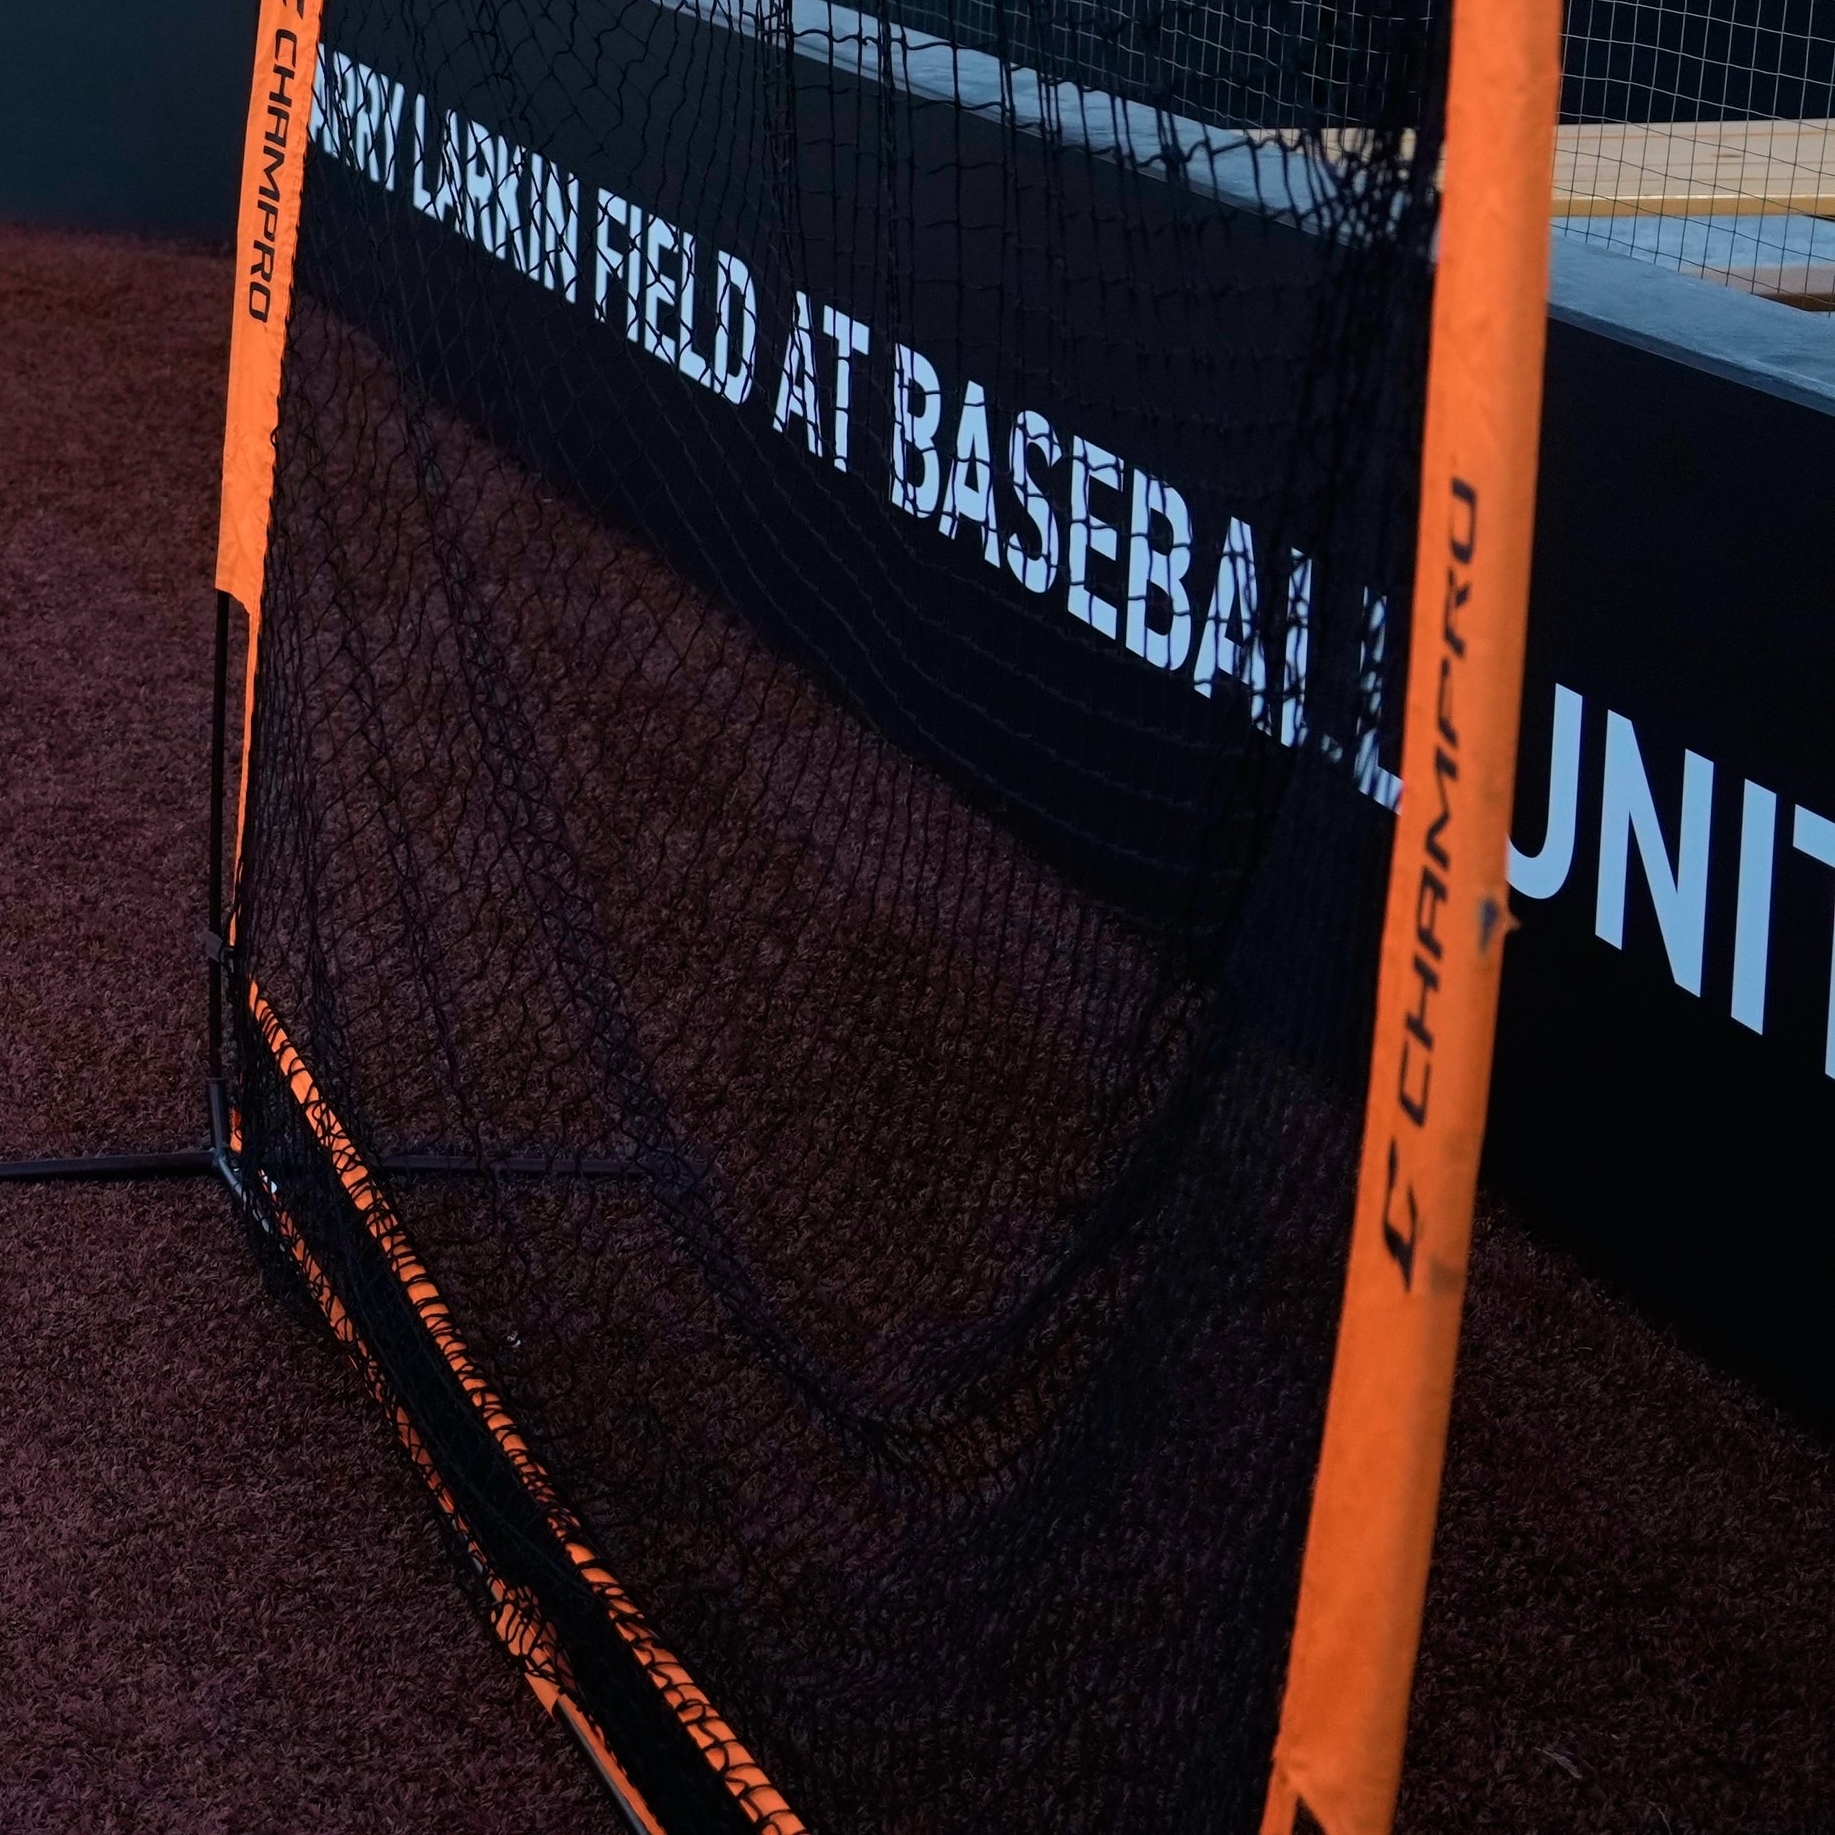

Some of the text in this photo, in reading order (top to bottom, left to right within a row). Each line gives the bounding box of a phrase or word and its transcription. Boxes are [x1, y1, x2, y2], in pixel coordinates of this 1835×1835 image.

[246, 27, 299, 326] CHAMPRO
[413, 91, 580, 306] LARKIN
[594, 185, 758, 406] FIELD
[771, 289, 872, 474] AT
[889, 341, 1406, 818] BASEBALL
[1397, 476, 1481, 1129] CHAMPRO
